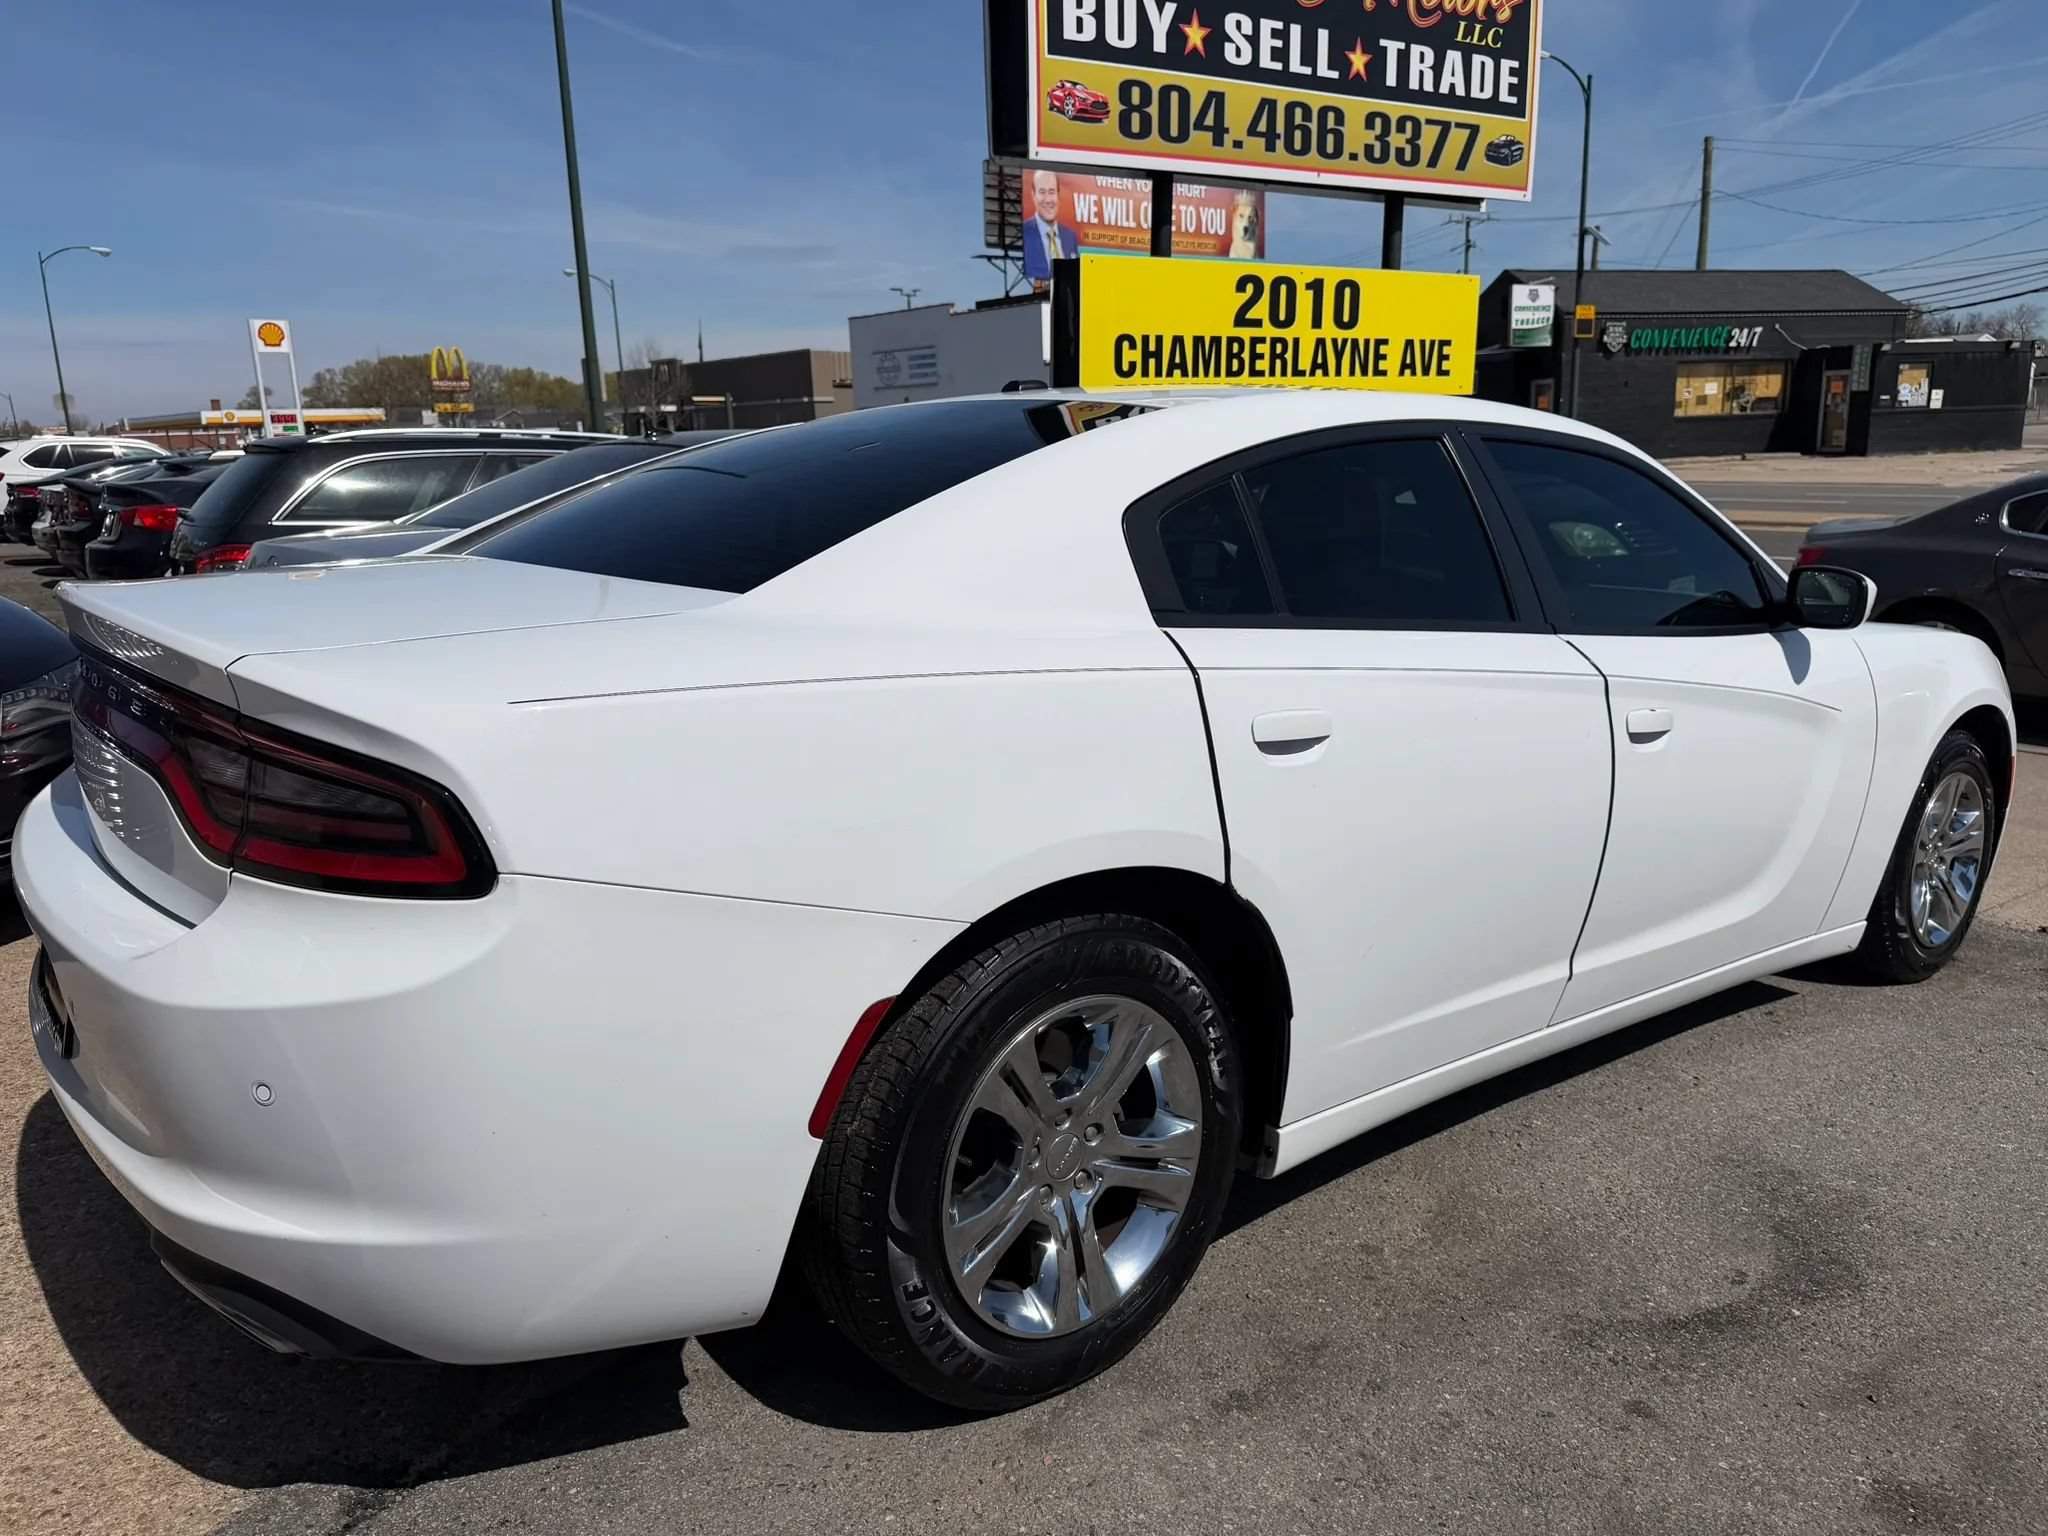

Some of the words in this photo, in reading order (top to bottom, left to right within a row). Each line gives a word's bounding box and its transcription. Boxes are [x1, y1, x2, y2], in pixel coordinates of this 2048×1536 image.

[1063, 0, 1177, 54] BUY
[1224, 12, 1339, 80] SELL
[1379, 38, 1520, 104] TRADE
[1454, 20, 1504, 48] LLC
[1118, 79, 1480, 171] 804.466.3377
[1095, 175, 1132, 191] WHEN
[1177, 183, 1207, 199] HURT
[1073, 192, 1099, 224] WE
[1102, 195, 1136, 229] WILL
[1178, 205, 1197, 234] TO
[1200, 207, 1226, 236] YOU
[1232, 273, 1361, 331] 2010
[1114, 333, 1389, 379] CHAMBERLAYNE
[1397, 339, 1452, 377] AVE
[1630, 325, 1730, 349] CONVENIENCE
[1728, 326, 1764, 348] 24/7
